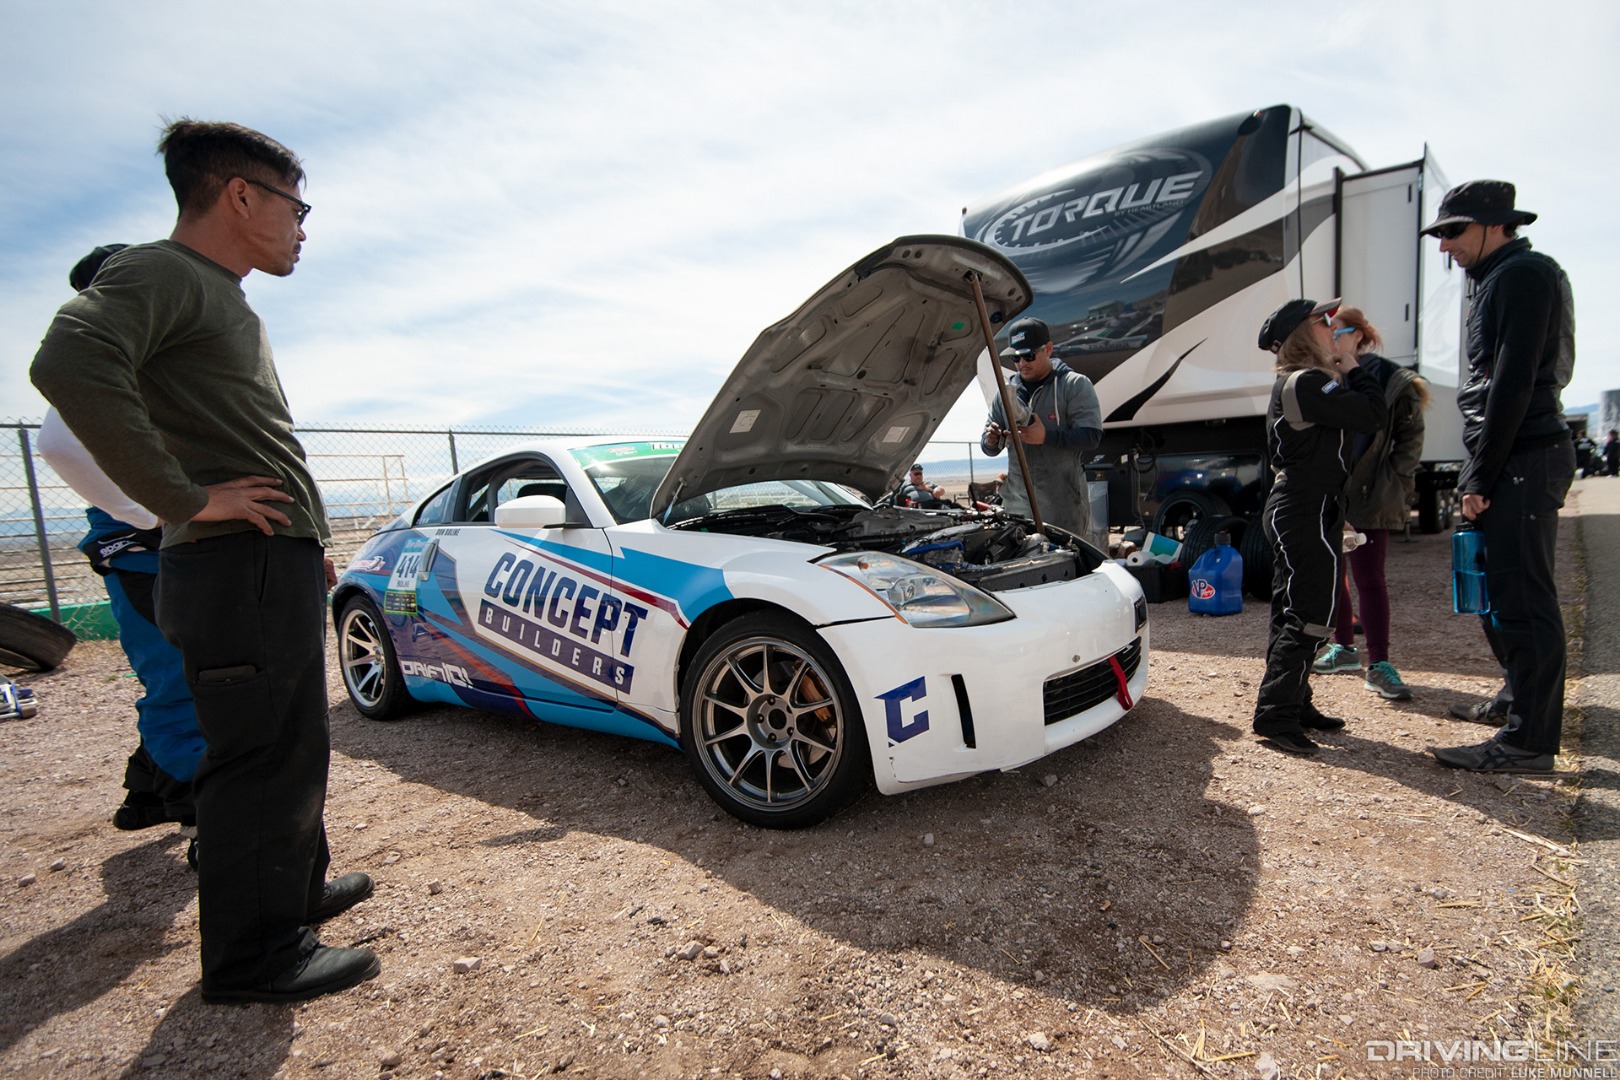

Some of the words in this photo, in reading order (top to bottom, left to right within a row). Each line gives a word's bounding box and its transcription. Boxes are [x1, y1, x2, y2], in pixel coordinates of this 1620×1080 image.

[1010, 170, 1204, 242] TORQUE
[396, 555, 420, 578] 414
[1191, 578, 1208, 598] VP
[484, 551, 649, 658] CONCEPT
[485, 607, 625, 685] BUILDERS
